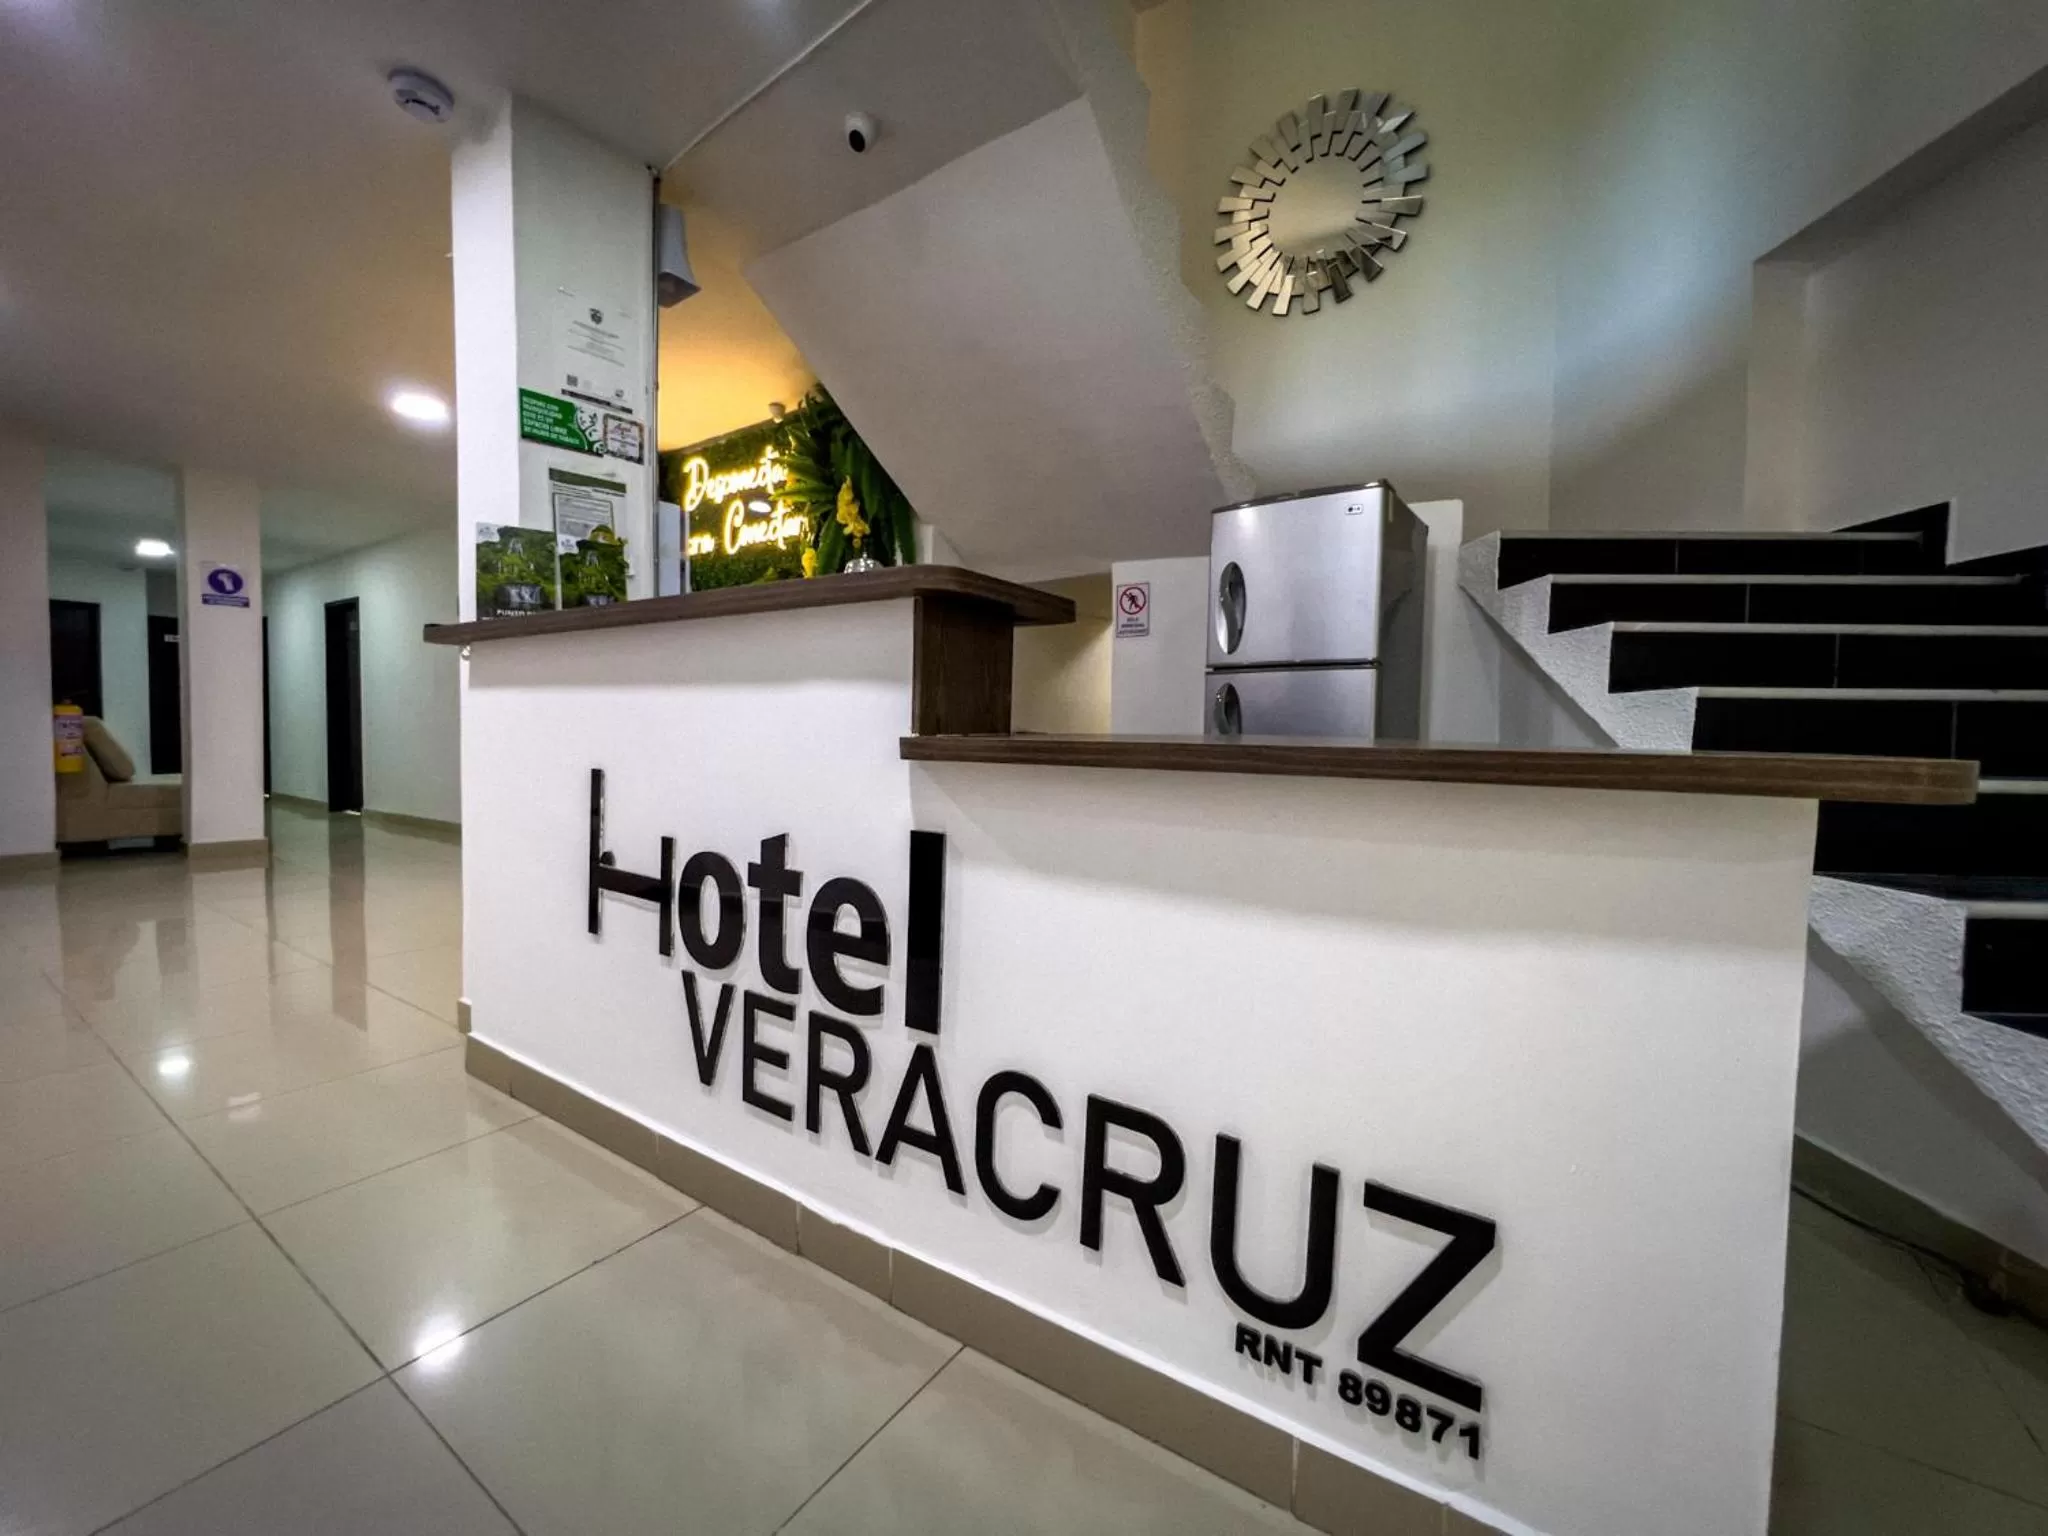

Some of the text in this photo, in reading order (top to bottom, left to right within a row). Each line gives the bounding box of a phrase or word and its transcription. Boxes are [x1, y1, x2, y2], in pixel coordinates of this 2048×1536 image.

[588, 768, 947, 1035] Hotel
[682, 970, 1497, 1413] VERACRUZ
[1235, 1322, 1480, 1460] RNT 89871
